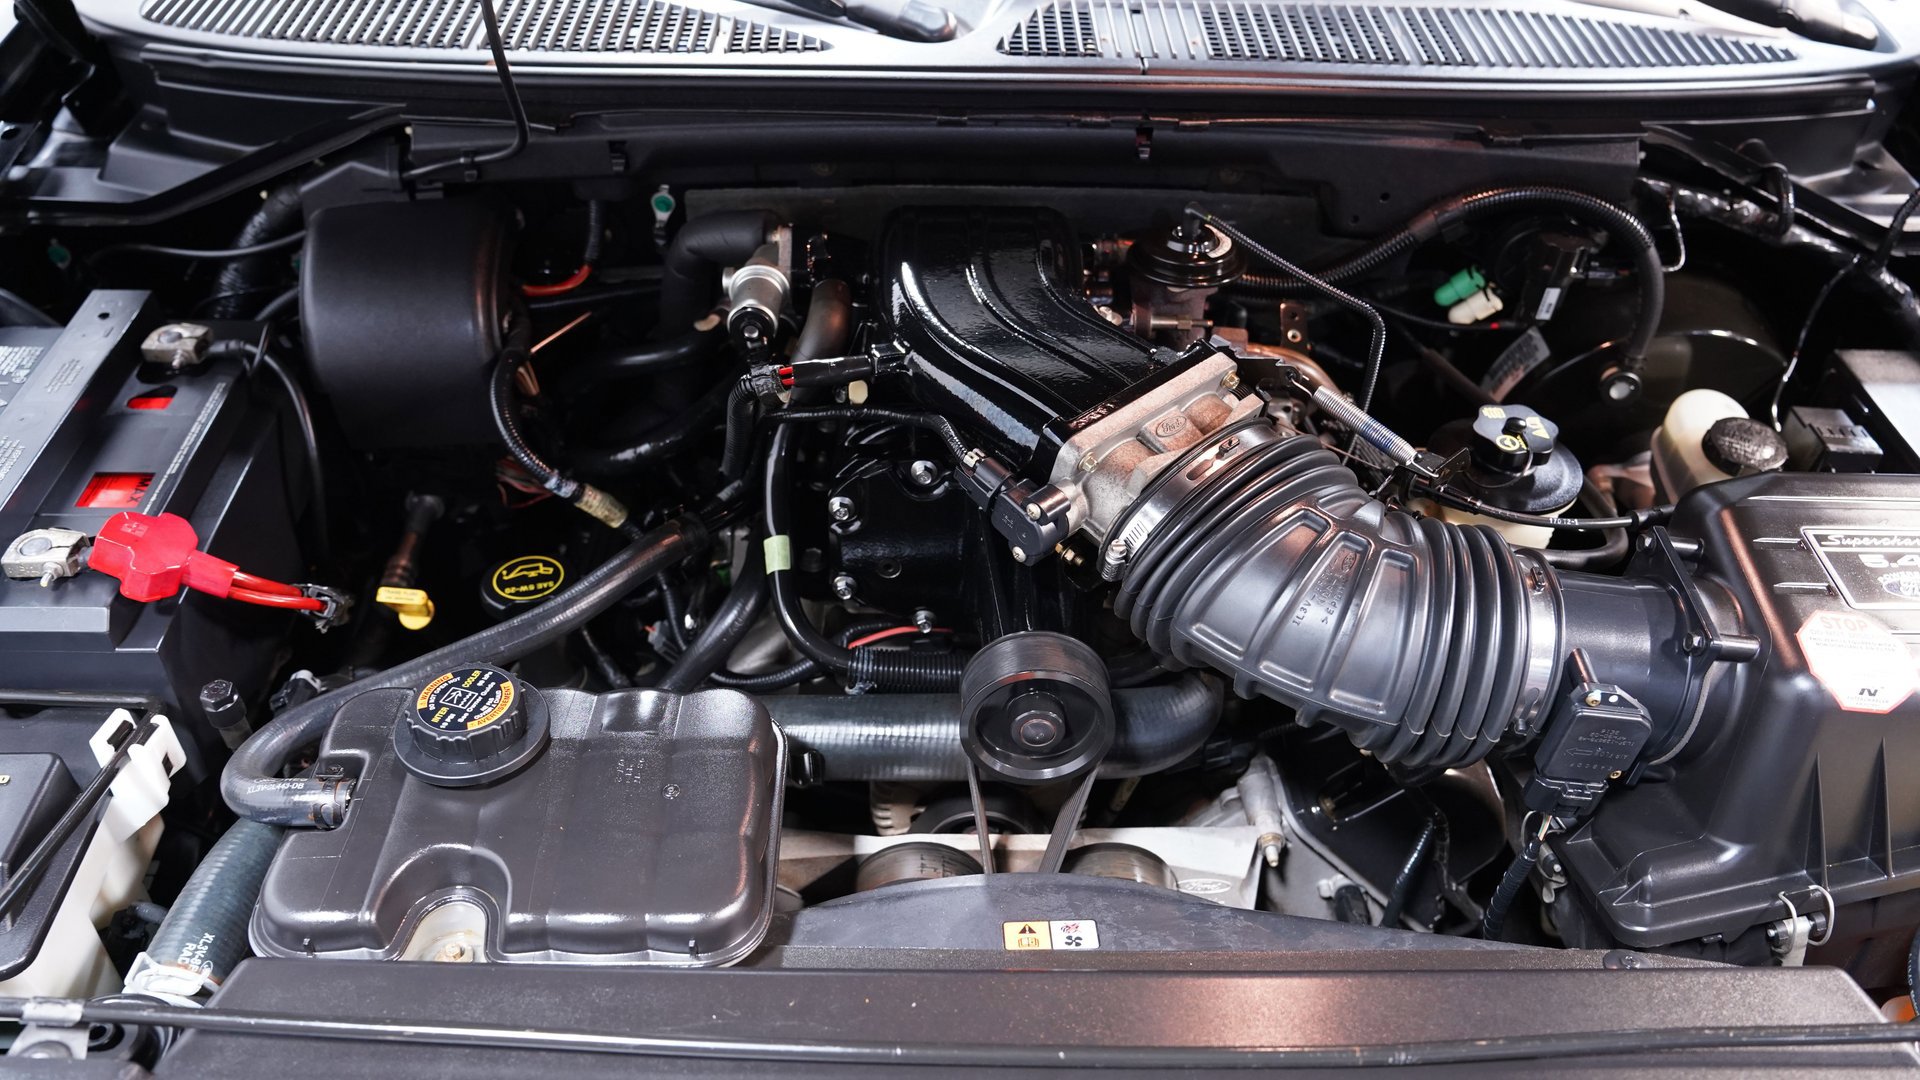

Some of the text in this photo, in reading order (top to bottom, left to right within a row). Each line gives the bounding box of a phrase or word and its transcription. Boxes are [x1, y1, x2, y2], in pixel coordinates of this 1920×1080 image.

[129, 476, 152, 503] MAX
[537, 581, 554, 590] SAE
[1820, 616, 1868, 631] STOP
[421, 675, 449, 700] WARNING
[462, 670, 482, 688] COOLER
[477, 685, 511, 726] AVERTISSEMENT
